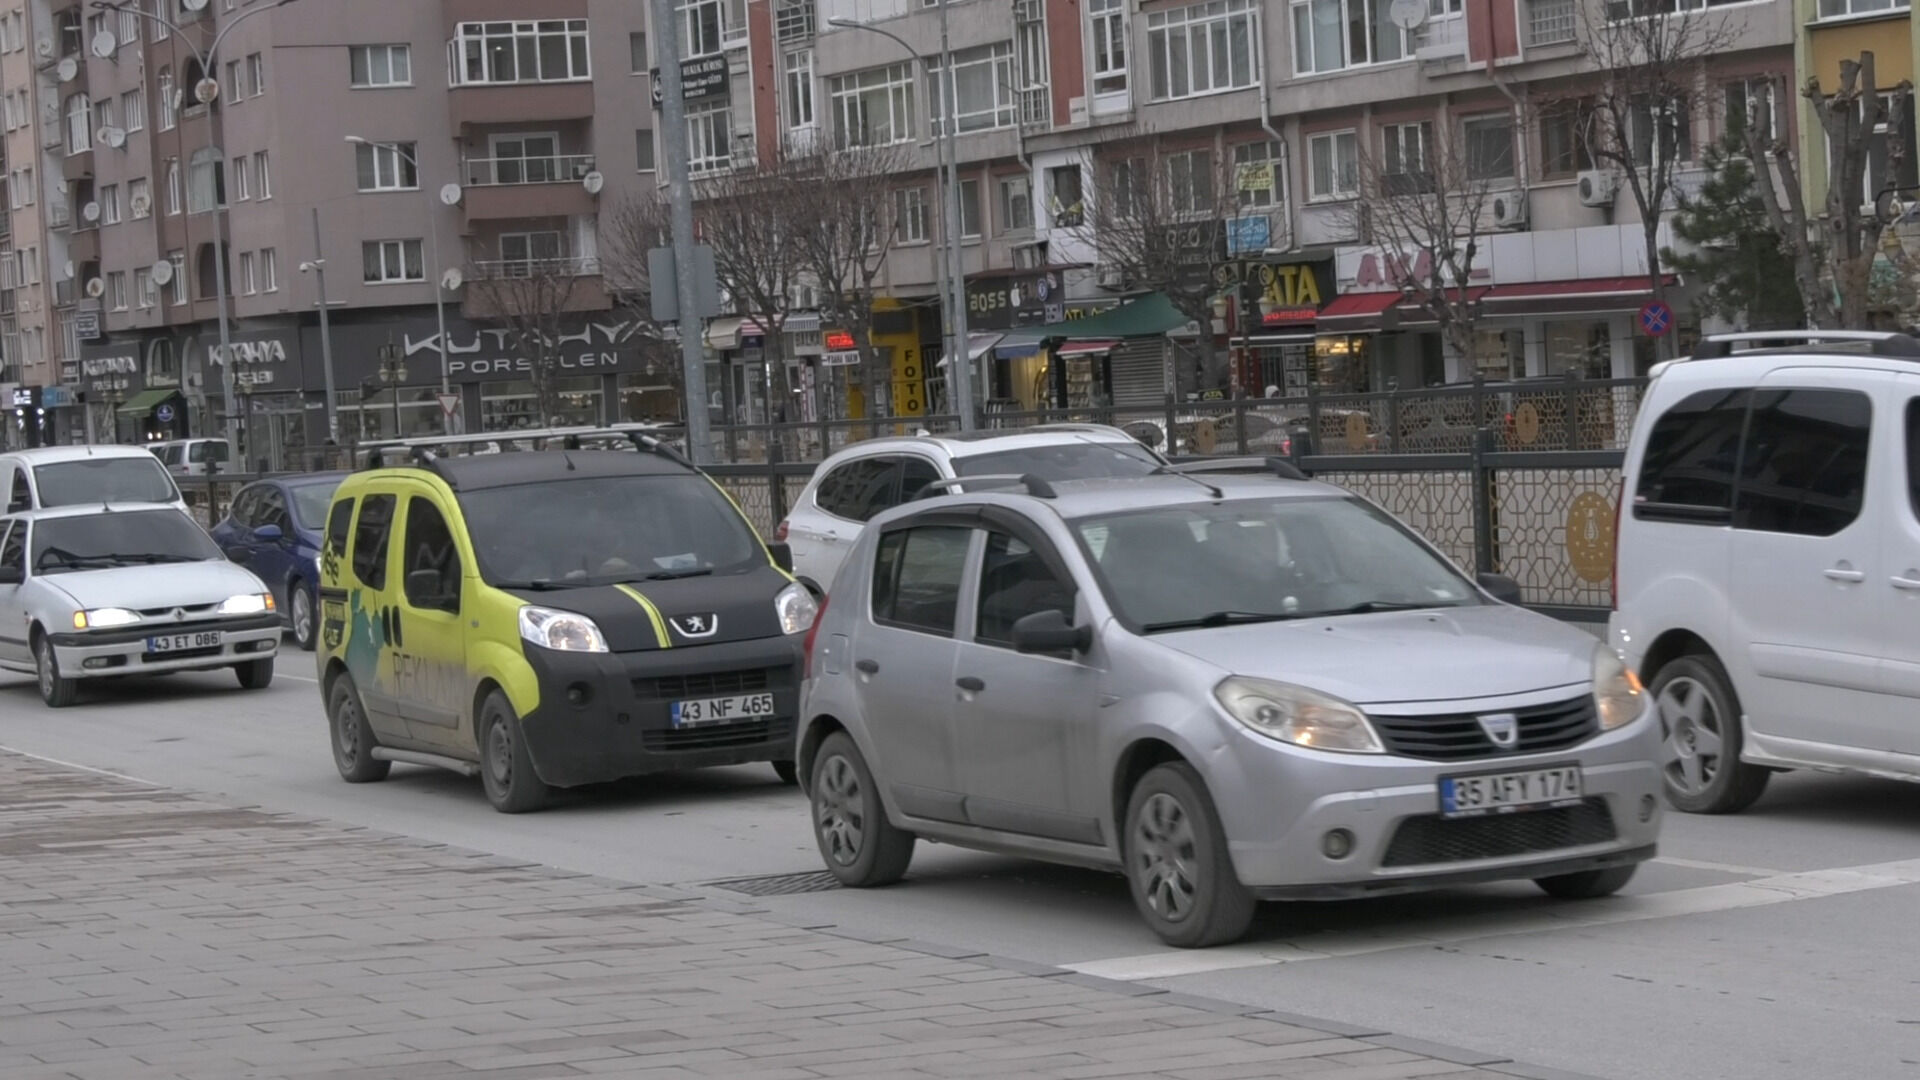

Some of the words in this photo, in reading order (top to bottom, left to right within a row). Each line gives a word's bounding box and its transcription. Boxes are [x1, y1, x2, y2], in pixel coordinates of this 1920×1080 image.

[208, 340, 286, 367] KTAHYA
[448, 352, 618, 375] PORSELEN
[904, 349, 919, 412] FOTO
[155, 637, 170, 650] 43
[175, 635, 189, 649] ET
[681, 702, 701, 720] 43
[710, 699, 733, 718] NF
[742, 695, 772, 714] 465
[1456, 779, 1482, 806] 35
[1490, 775, 1530, 803] AFY
[1539, 769, 1577, 797] 174
